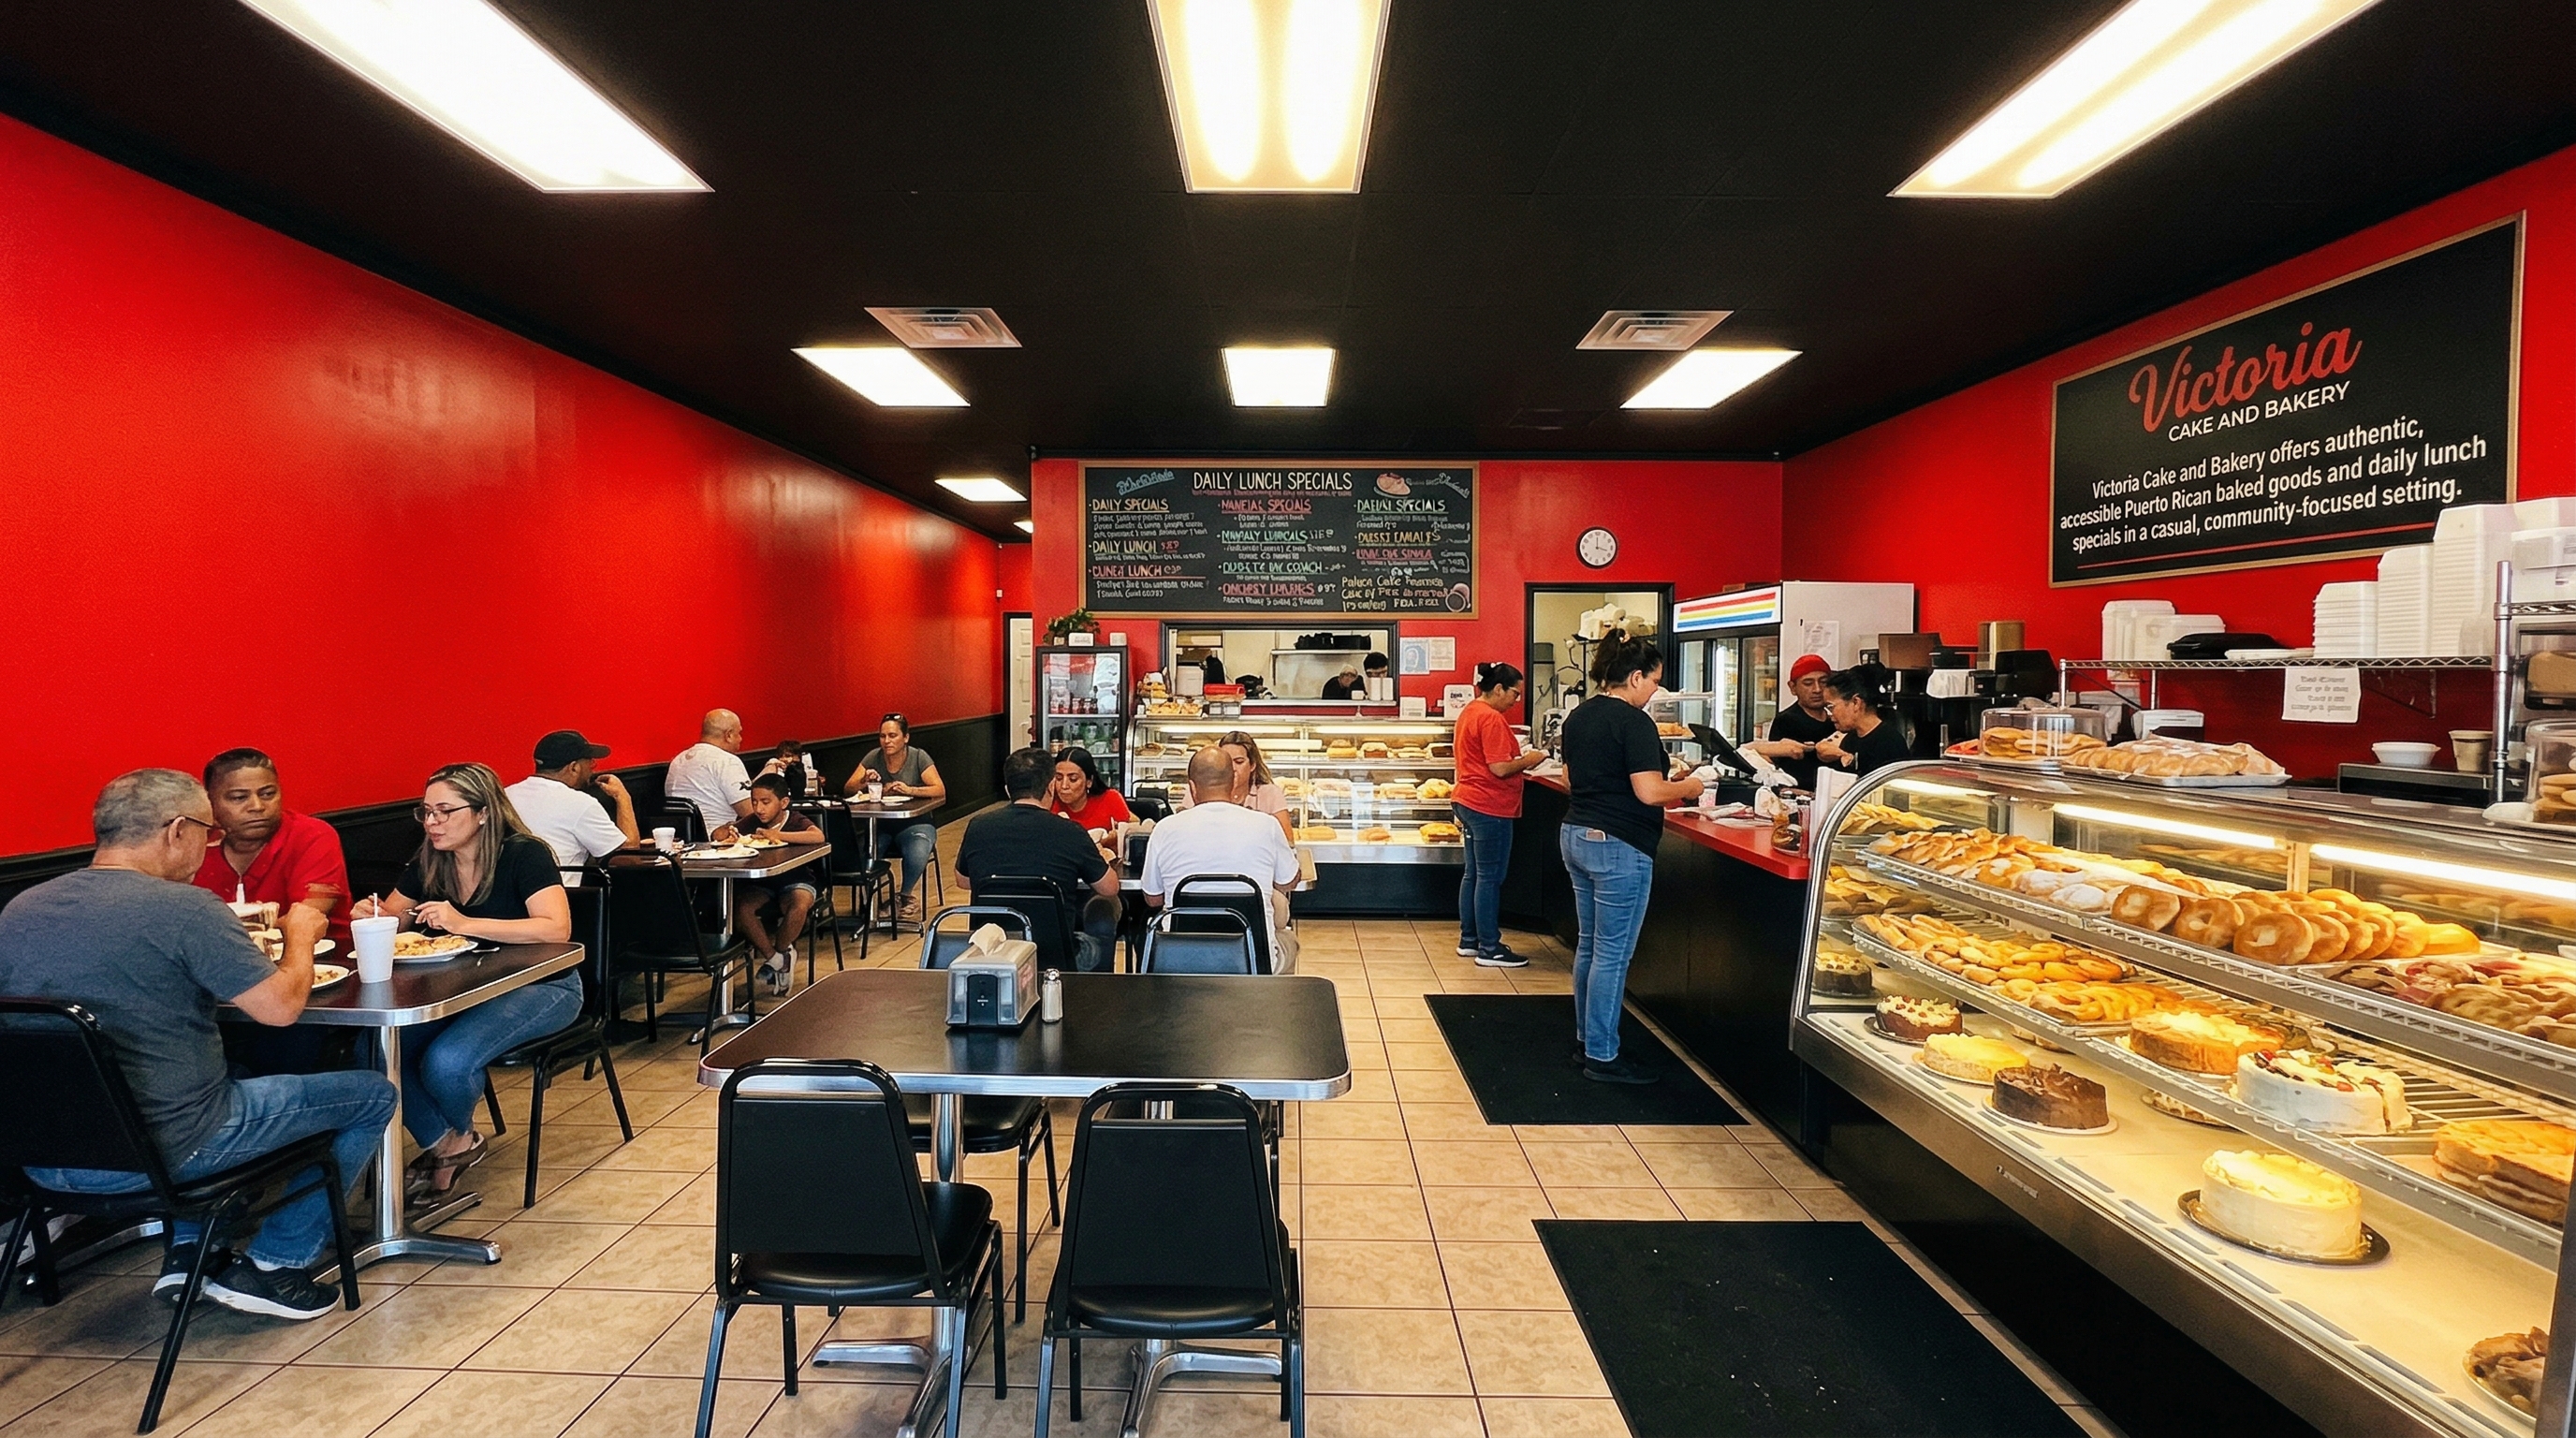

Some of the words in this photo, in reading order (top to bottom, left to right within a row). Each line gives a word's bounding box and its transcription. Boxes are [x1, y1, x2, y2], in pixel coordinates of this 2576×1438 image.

[2129, 321, 2363, 433] Victoria
[2168, 417, 2214, 442] CAKE
[2217, 405, 2260, 431] AND
[2264, 380, 2350, 418] BAKERY
[1193, 472, 1233, 490] DAILY
[1239, 472, 1281, 490] LUNCH
[1287, 472, 1353, 490] SPECIALS
[2060, 503, 2122, 530] accessible
[2125, 496, 2169, 519] Puerto
[2172, 489, 2212, 510] Rican
[2216, 475, 2264, 503] baked
[2268, 465, 2322, 499] goods
[2327, 456, 2363, 484] and
[2367, 448, 2419, 477] daily
[2423, 434, 2486, 467] lunch
[2092, 475, 2140, 499] Victoria
[2143, 467, 2176, 490] Cake
[2179, 459, 2206, 483] and
[2210, 451, 2266, 476] Bakery
[2269, 439, 2320, 464] offers
[2324, 416, 2424, 454] authentic,
[1092, 498, 1121, 511] DAILY
[2072, 527, 2122, 554] specials
[2124, 525, 2136, 544] in
[2139, 526, 2148, 541] a
[2150, 514, 2201, 539] casual,
[2203, 485, 2377, 532] community-focused
[2381, 477, 2462, 506] setting.
[1092, 540, 1120, 553] DAILY
[1128, 565, 1162, 577] LUNCH
